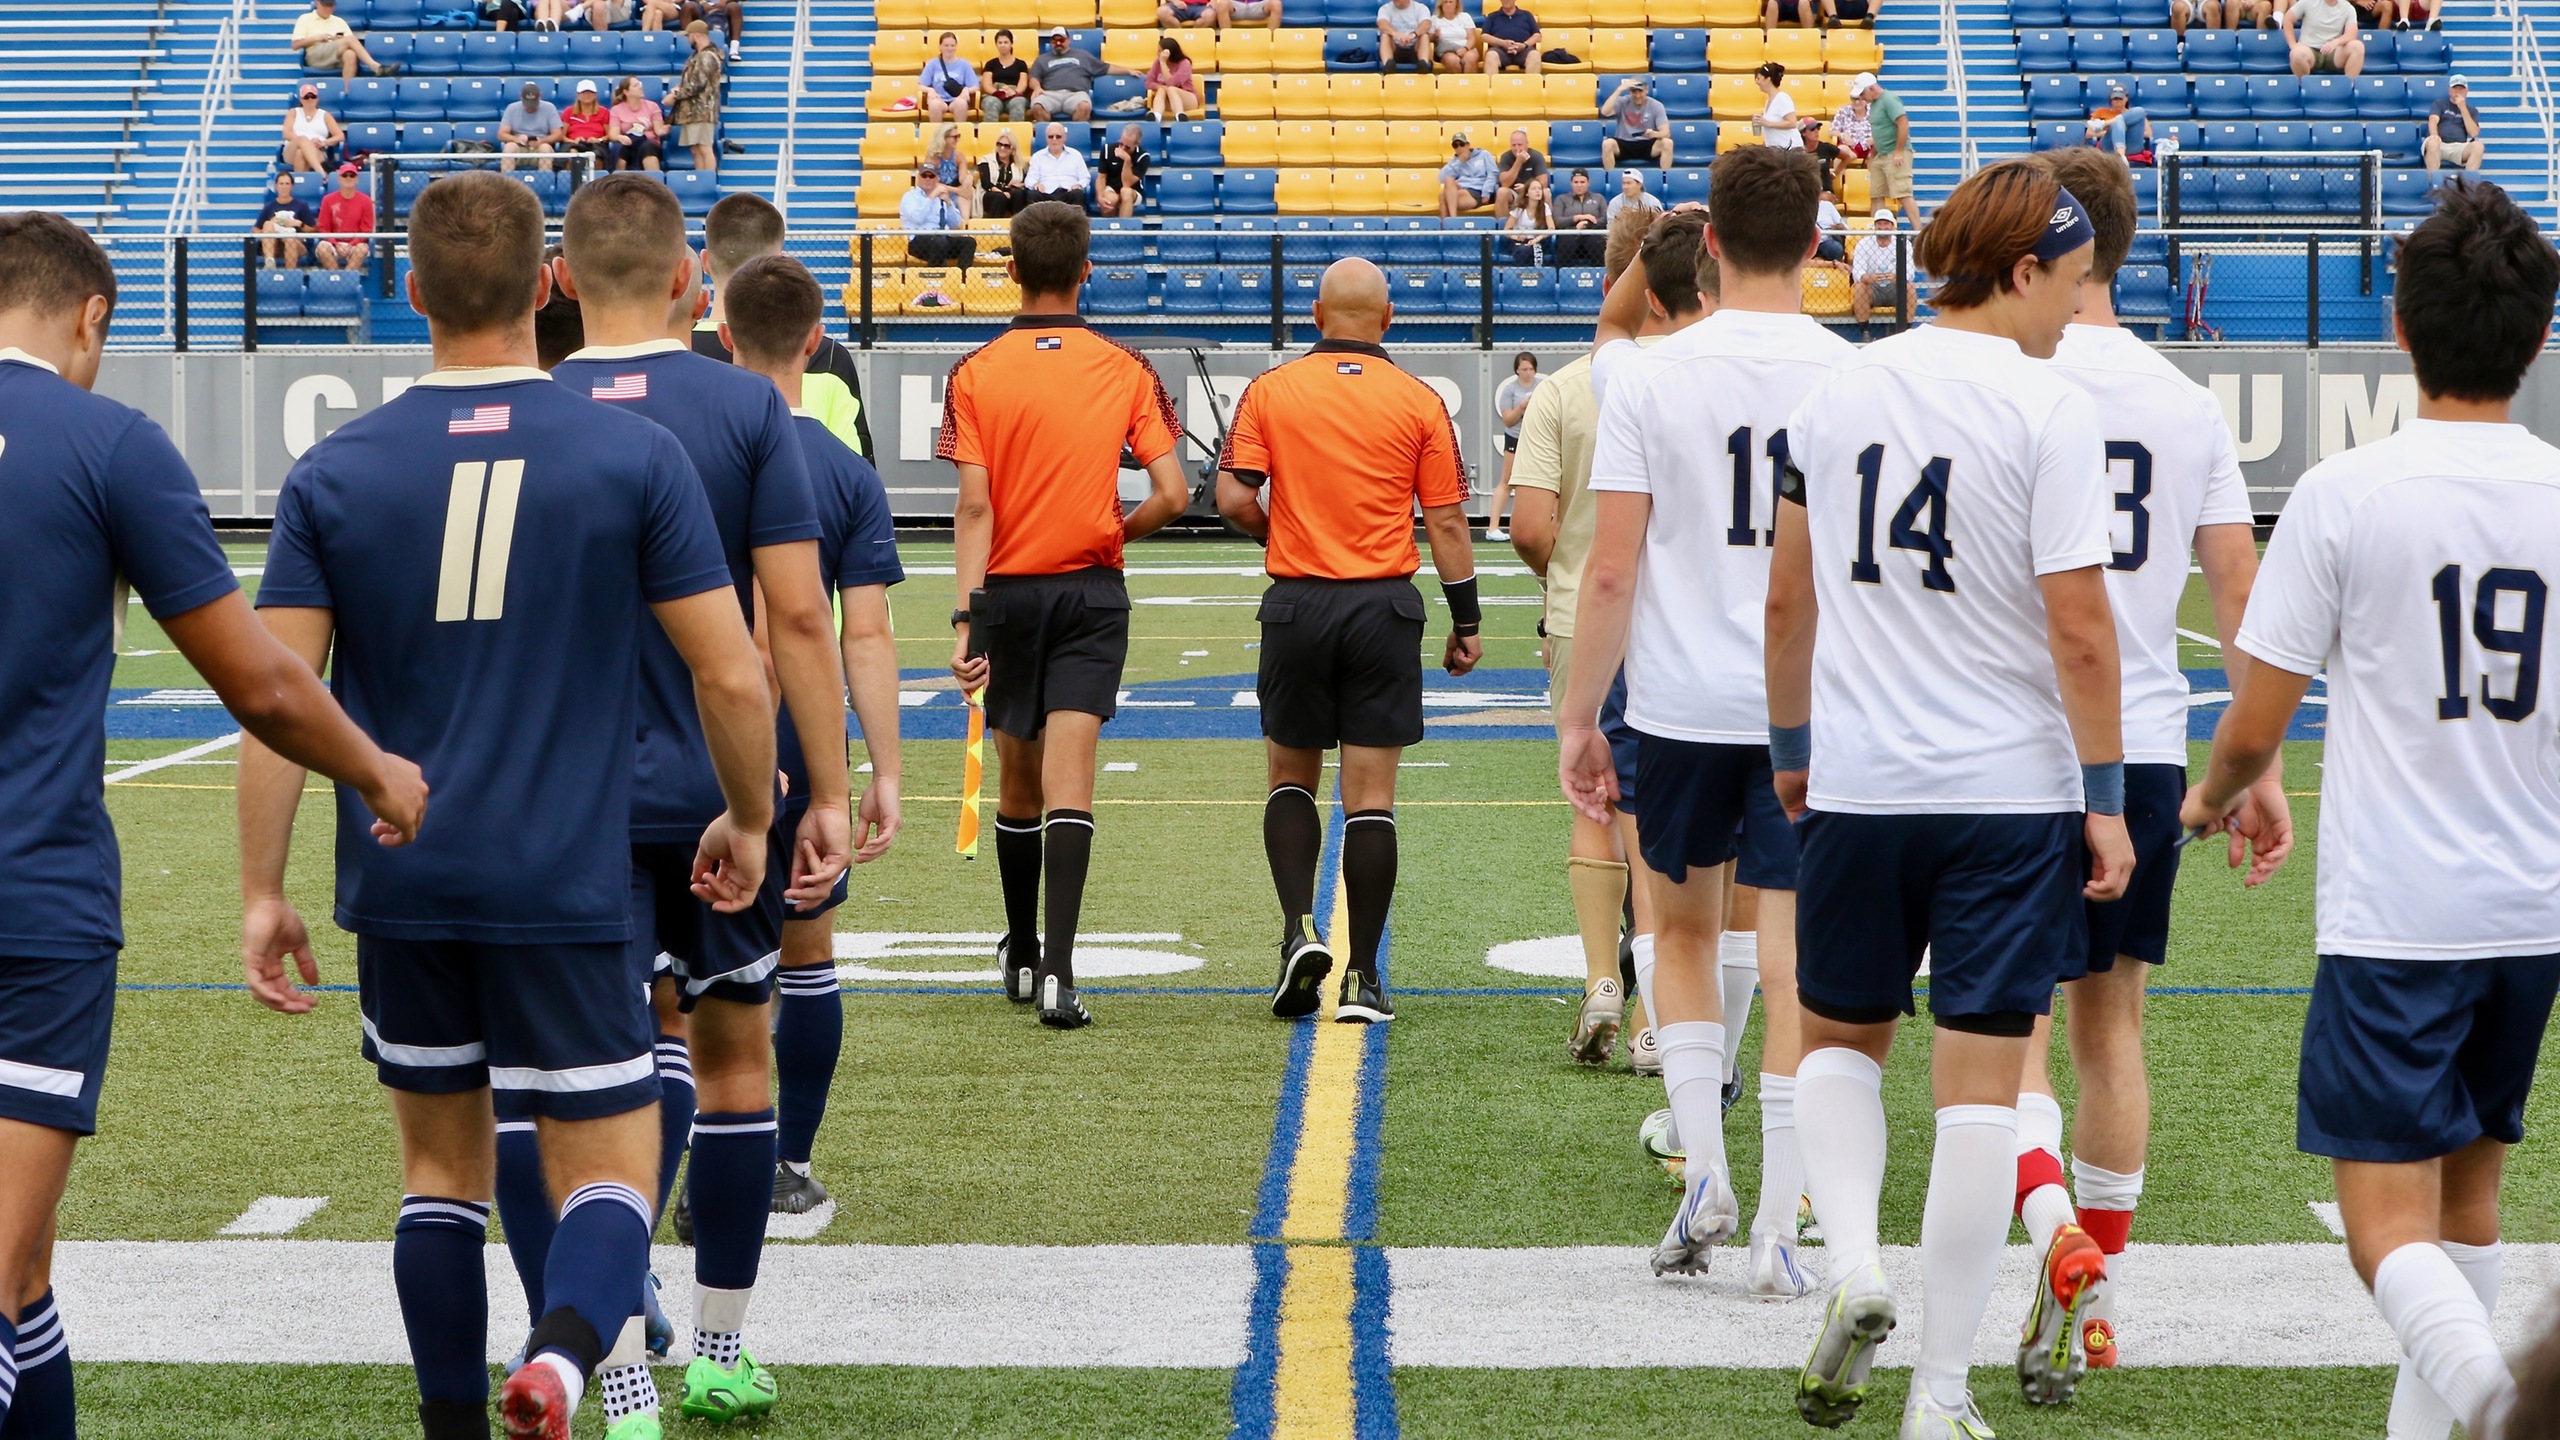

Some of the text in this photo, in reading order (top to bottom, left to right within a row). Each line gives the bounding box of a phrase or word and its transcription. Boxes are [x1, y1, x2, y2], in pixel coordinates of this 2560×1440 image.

[2055, 215, 2080, 234] umbro
[436, 459, 525, 622] 11
[1726, 424, 1788, 549] 11
[1850, 440, 1957, 594] 14
[2430, 562, 2549, 727] 19
